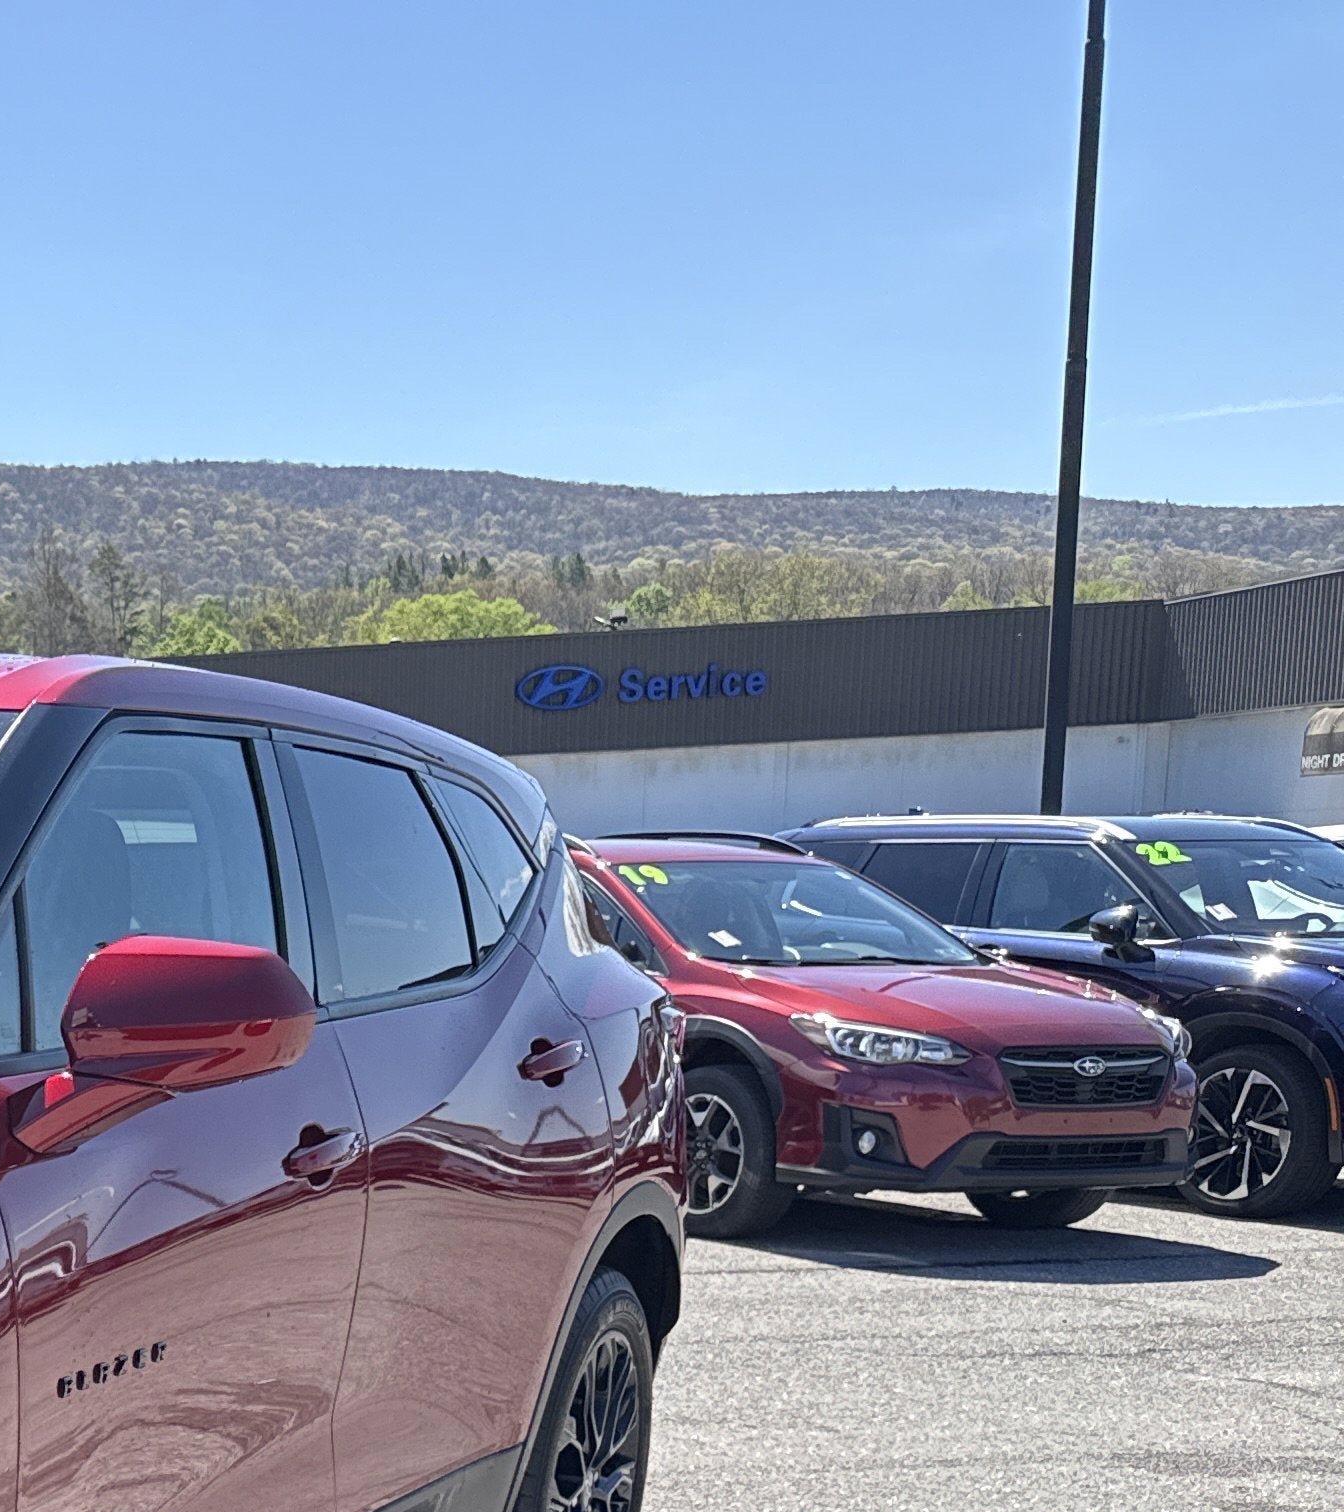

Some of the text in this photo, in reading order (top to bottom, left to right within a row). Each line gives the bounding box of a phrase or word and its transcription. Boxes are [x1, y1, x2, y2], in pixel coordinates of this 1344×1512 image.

[618, 663, 768, 704] Service
[1301, 754, 1331, 769] NIGHT
[1135, 841, 1193, 866] 22
[618, 864, 669, 886] 19
[56, 1340, 168, 1399] BLAZER
